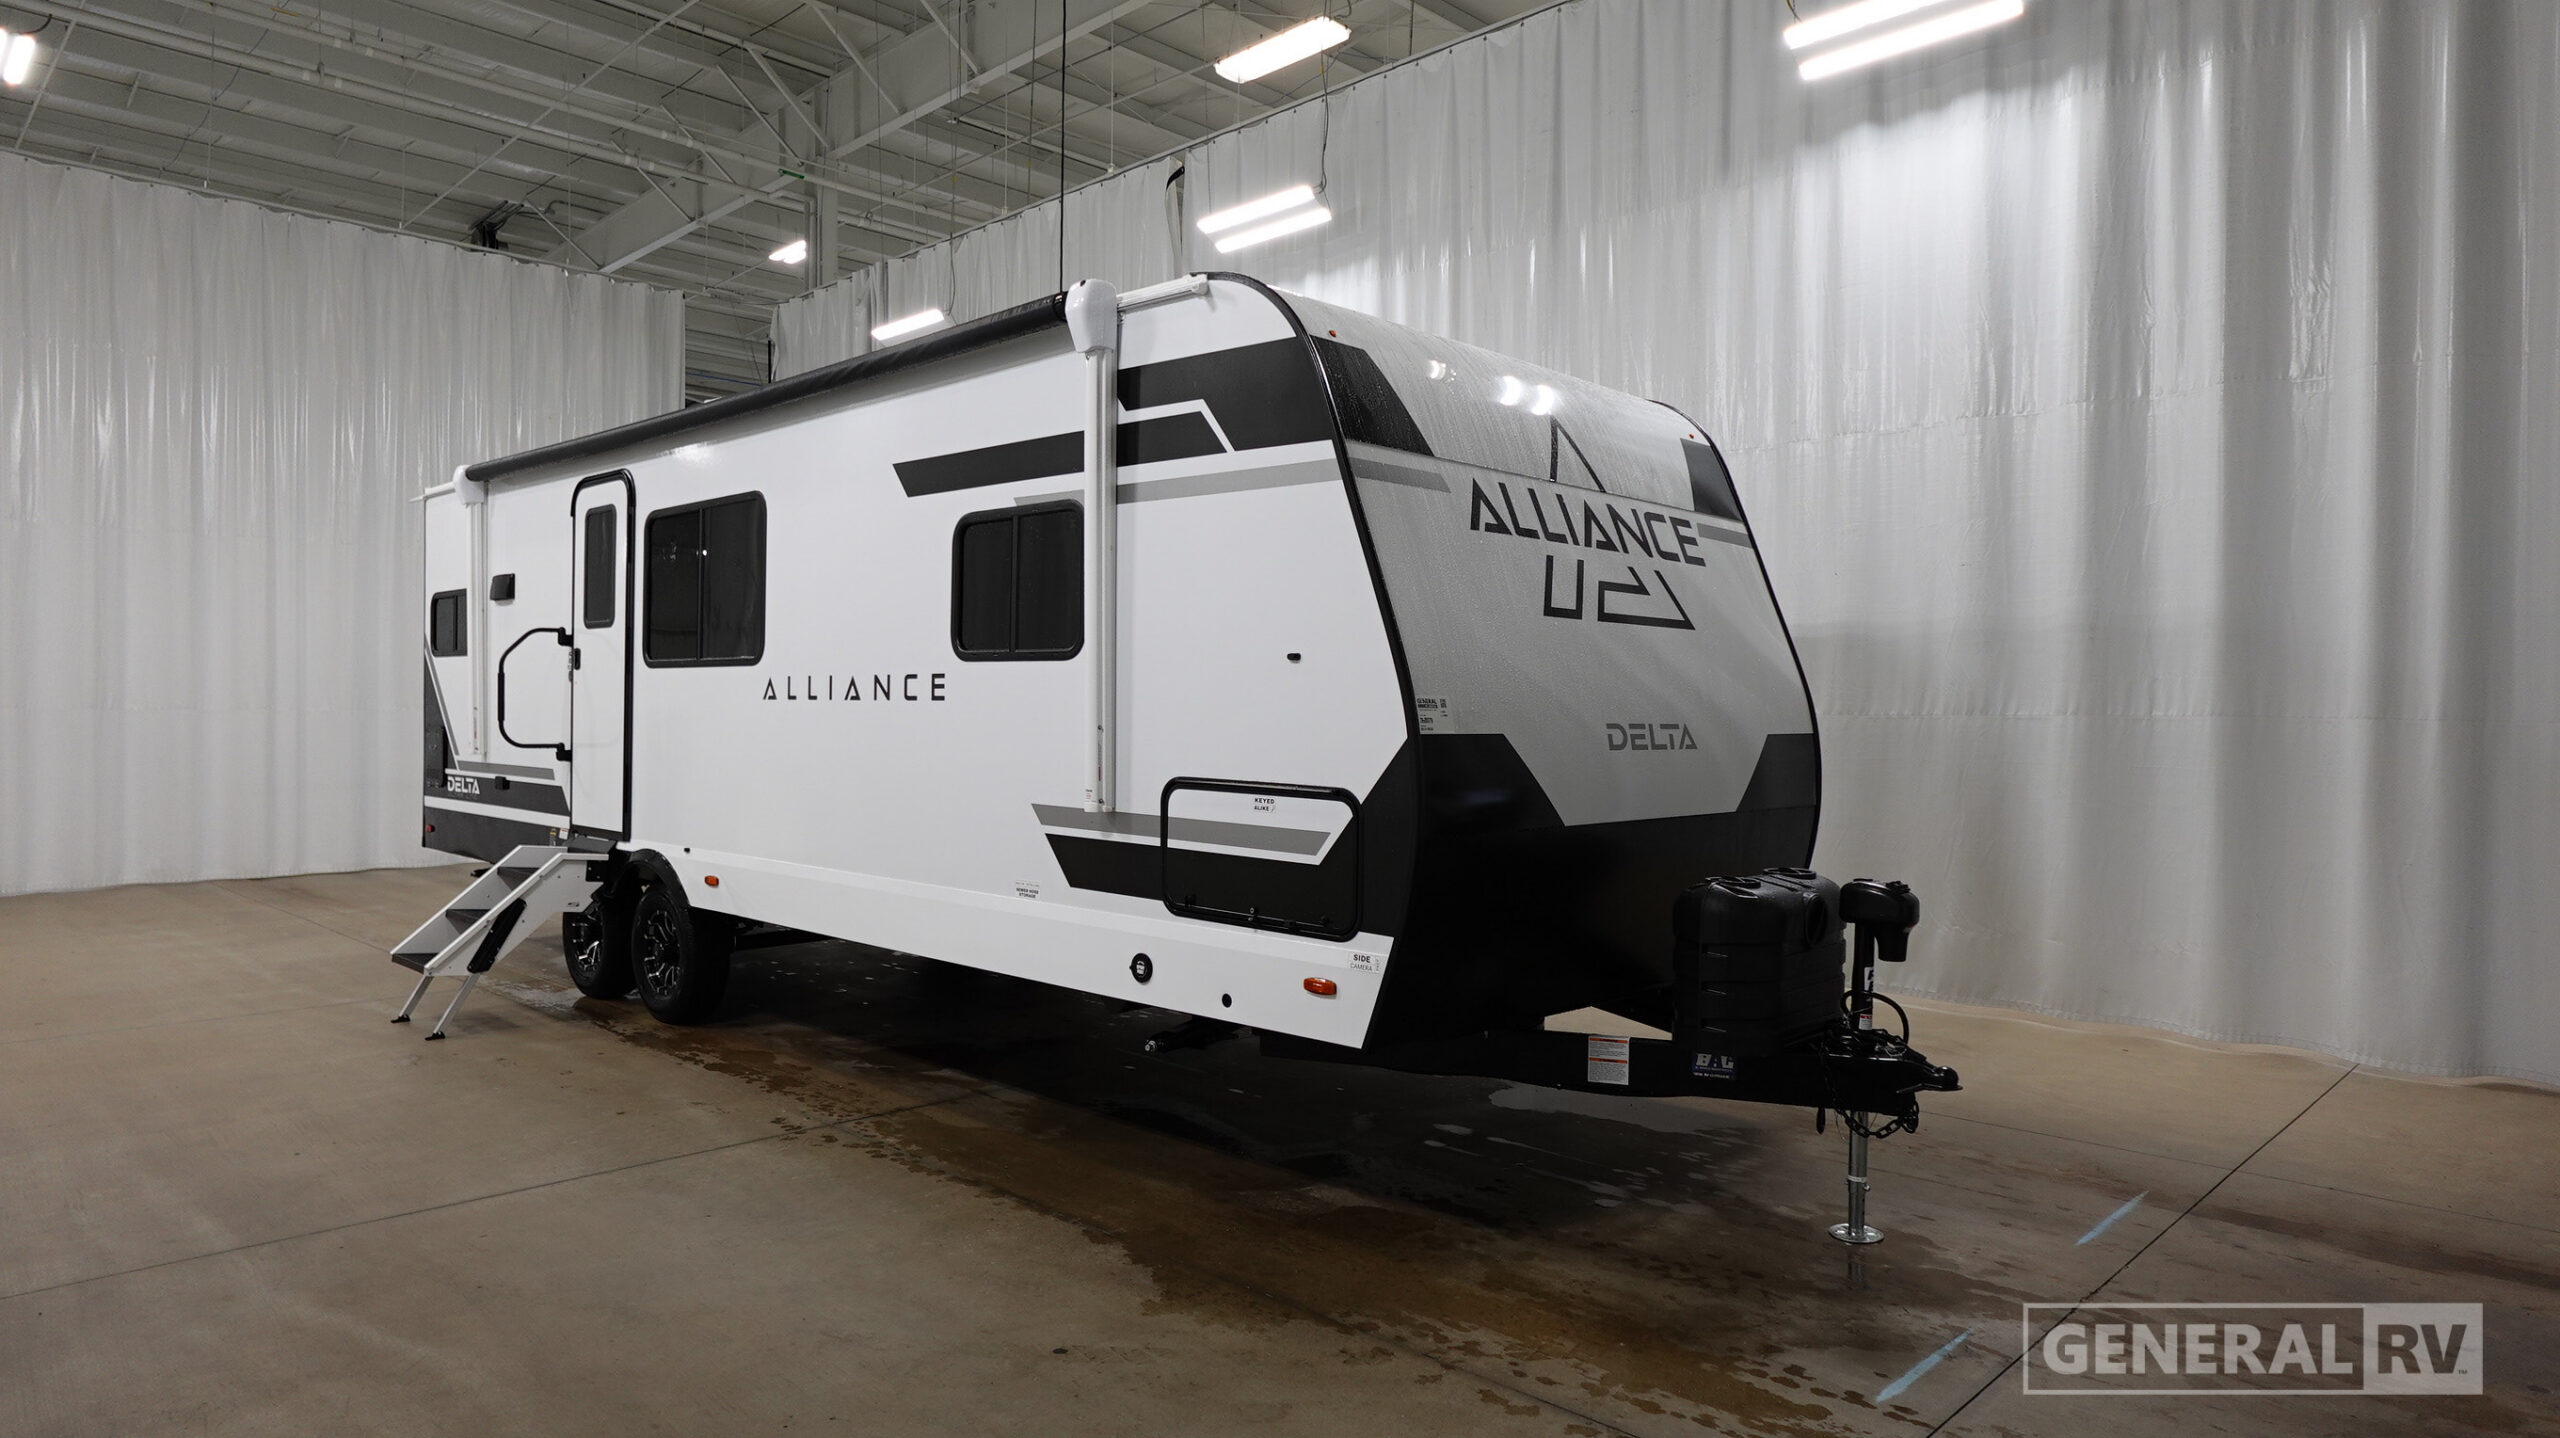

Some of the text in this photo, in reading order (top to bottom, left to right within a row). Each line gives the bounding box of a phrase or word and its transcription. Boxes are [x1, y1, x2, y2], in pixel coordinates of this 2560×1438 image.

[1470, 478, 1706, 567] ALLIANCE
[763, 673, 945, 701] ALLIANCE
[1606, 723, 1698, 751] DELTA
[447, 775, 480, 795] DELTA
[1350, 963, 1372, 971] CAMERA
[1353, 953, 1371, 963] SIDE
